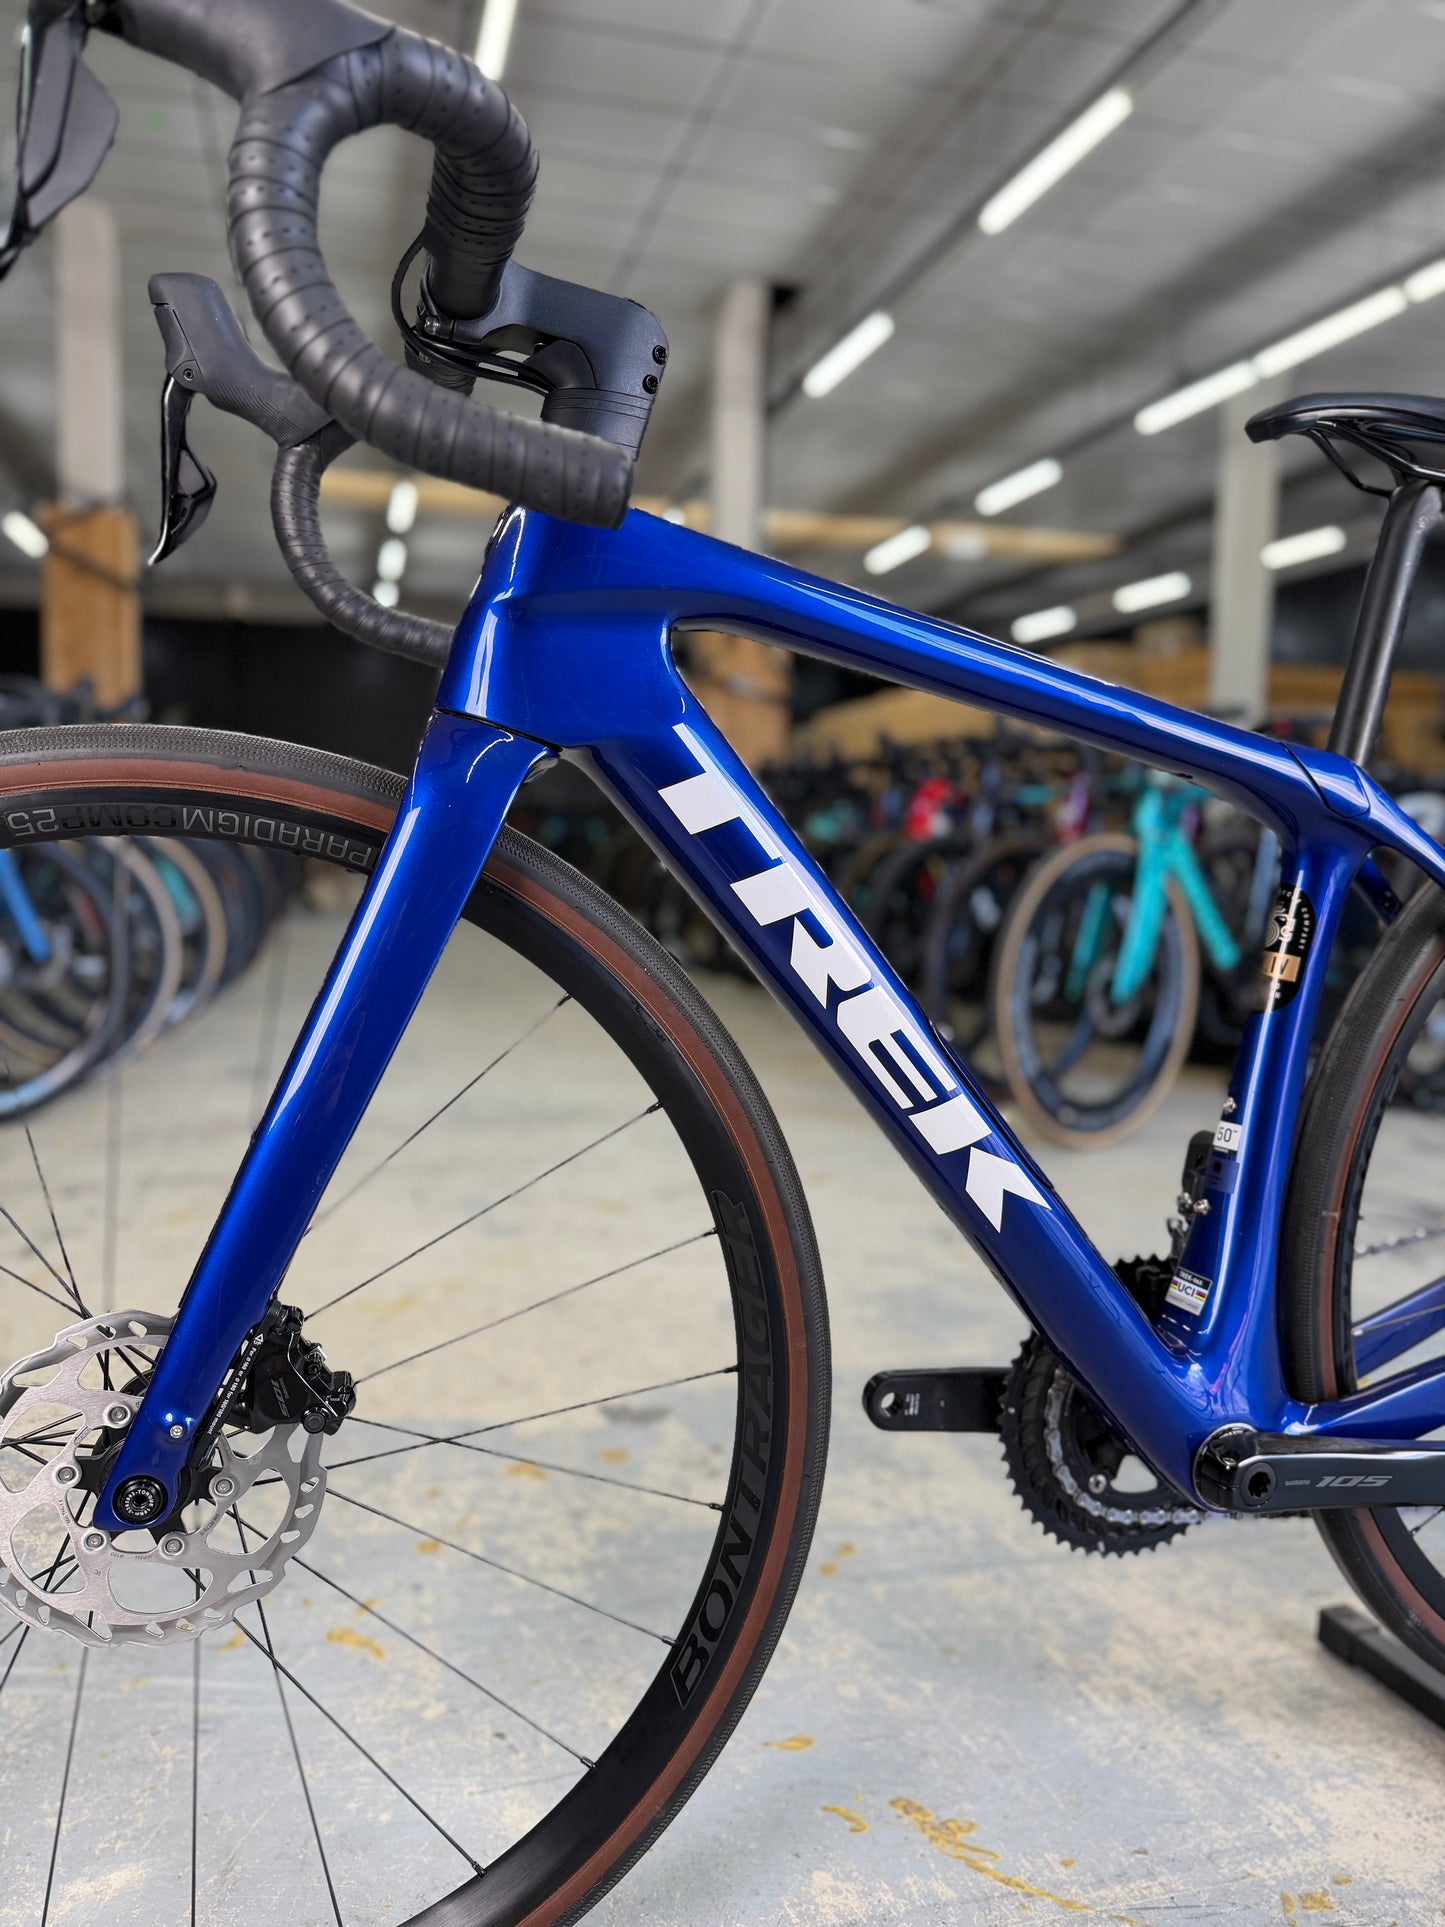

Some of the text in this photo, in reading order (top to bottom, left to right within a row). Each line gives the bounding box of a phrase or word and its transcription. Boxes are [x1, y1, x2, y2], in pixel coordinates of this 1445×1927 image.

[7, 805, 373, 868] PARADIGM COMP 25
[658, 723, 1051, 1234] TREK
[1177, 1282, 1196, 1297] UCI
[270, 1379, 290, 1418] 105
[672, 1190, 772, 1704] BONTRAGER
[1315, 1475, 1393, 1488] 105
